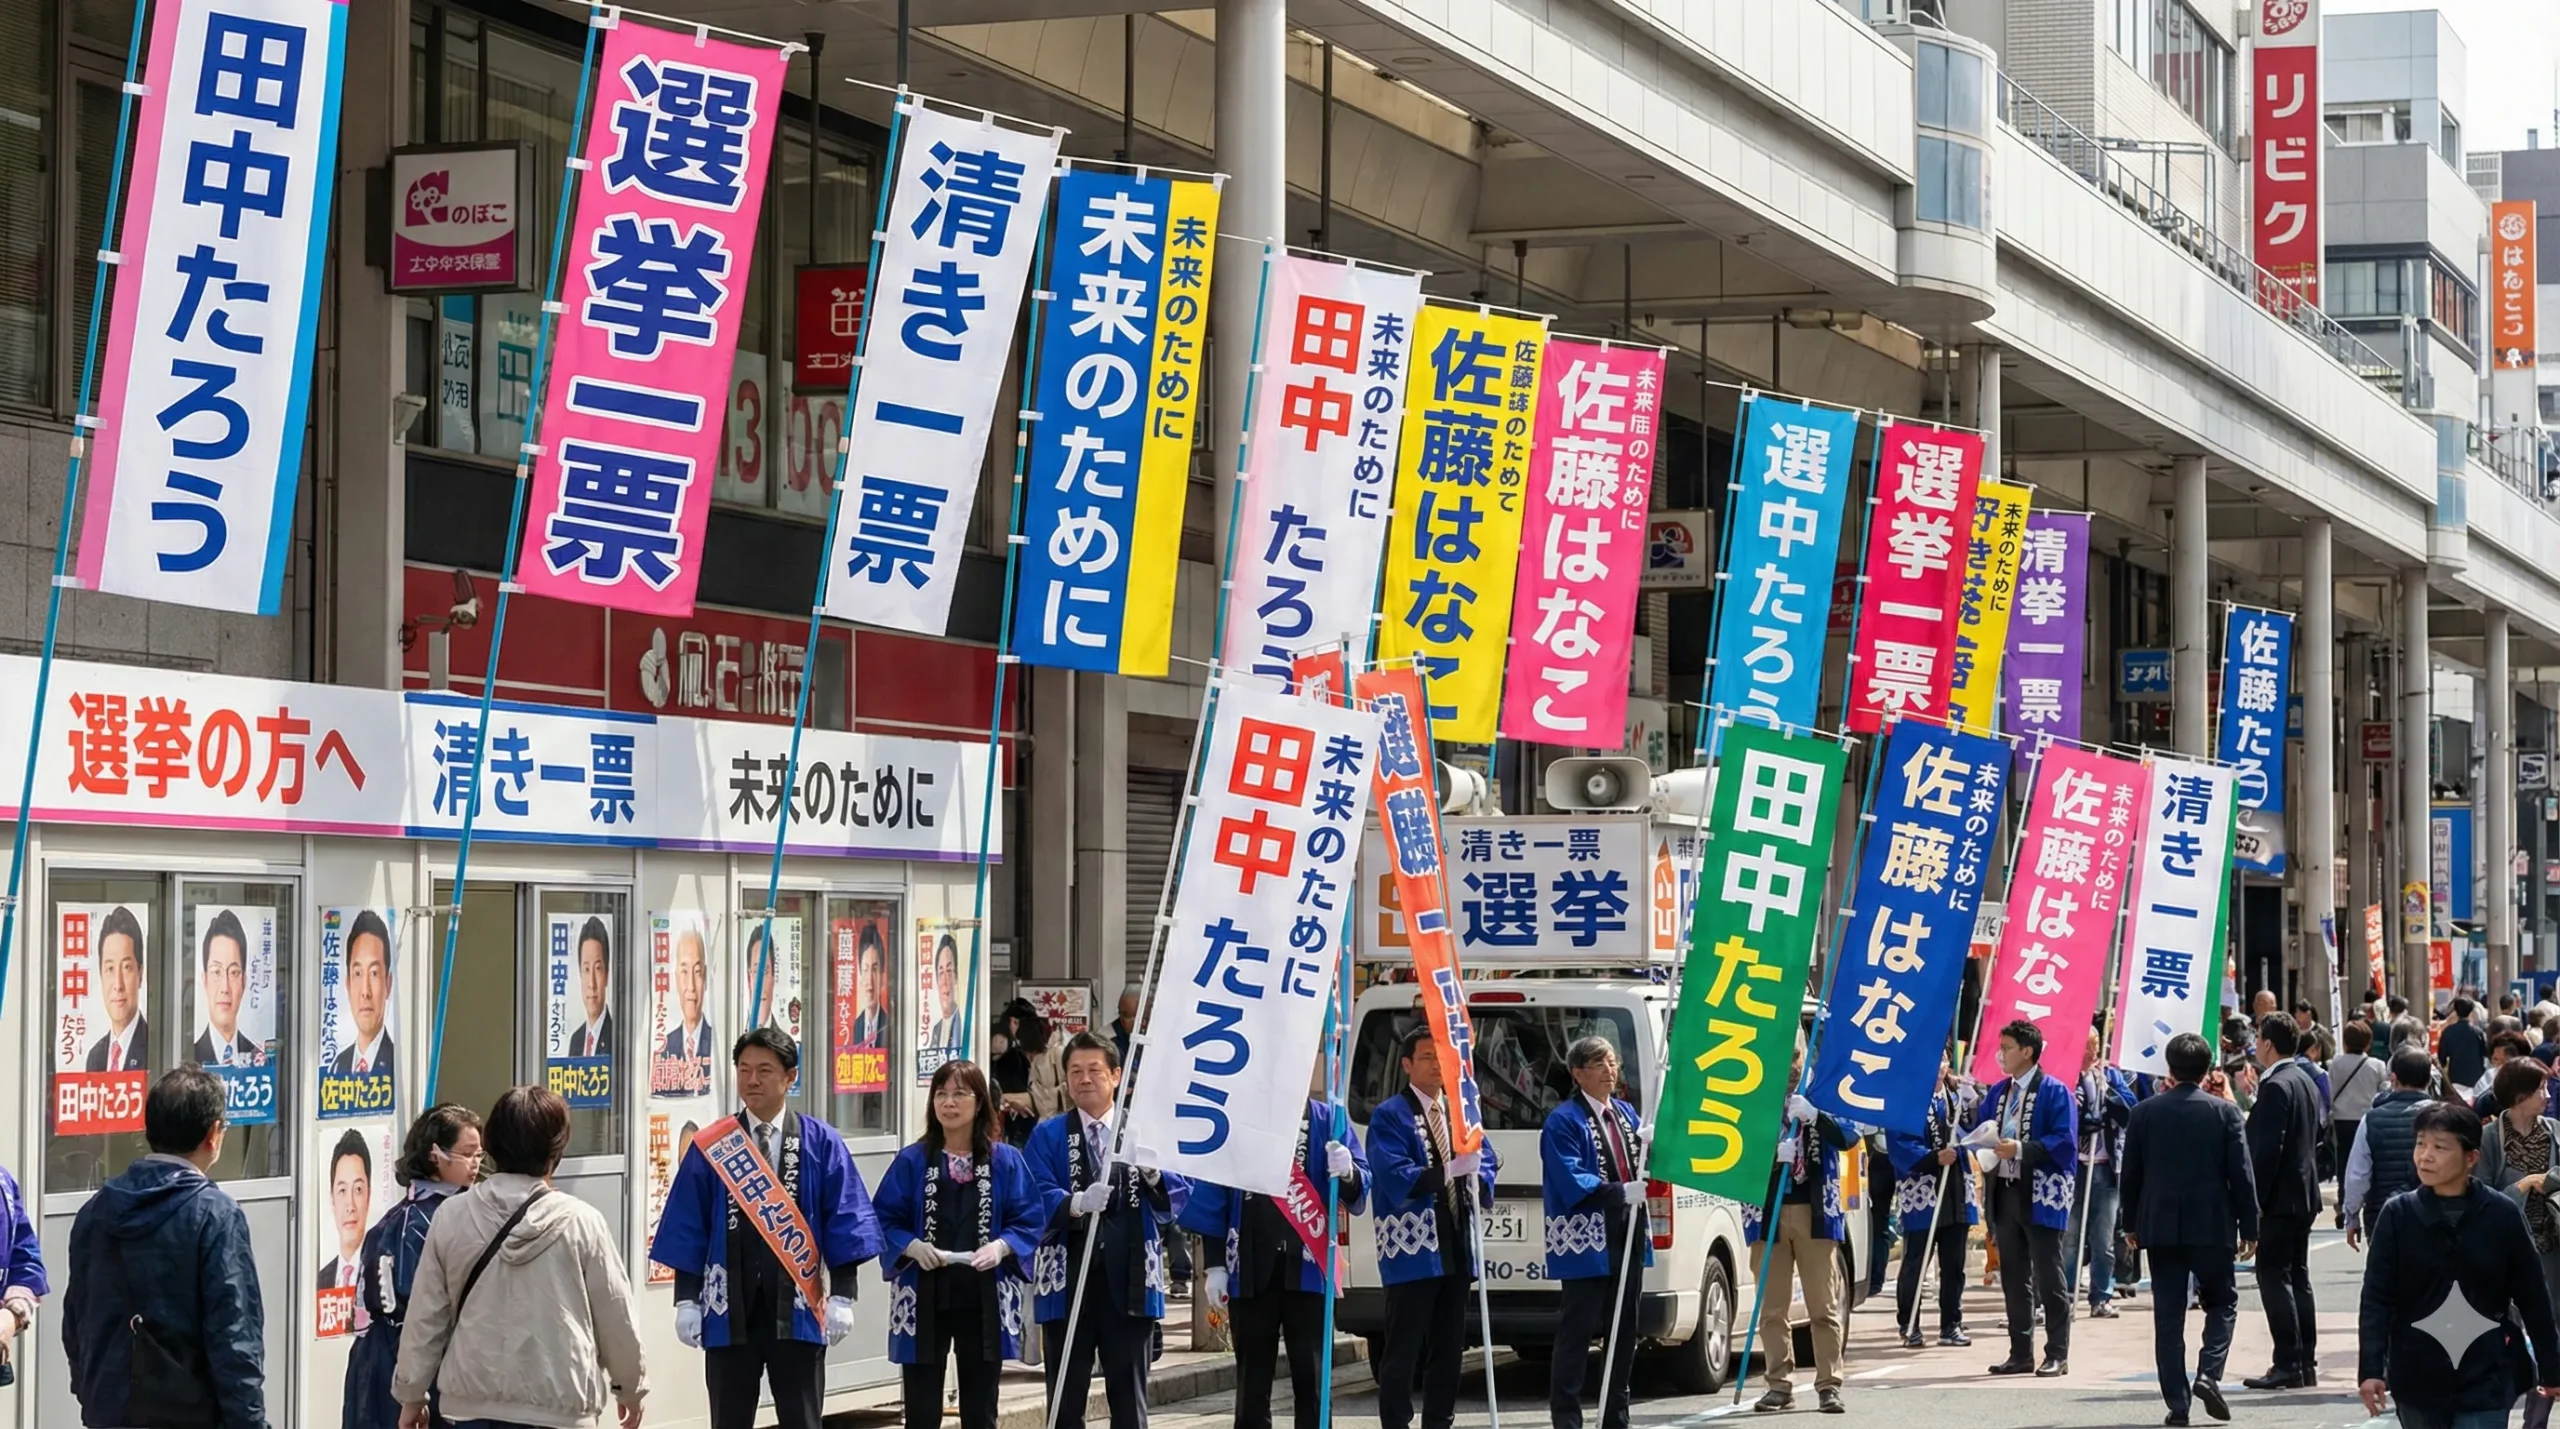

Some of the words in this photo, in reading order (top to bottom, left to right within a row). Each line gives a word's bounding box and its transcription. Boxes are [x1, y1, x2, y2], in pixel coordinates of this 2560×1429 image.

[2265, 73, 2306, 245] リビク
[151, 11, 307, 573] 田中たろう
[546, 57, 755, 588] 選挙一票
[847, 140, 1025, 590] 清き一票
[1153, 216, 1207, 440] 未来のために
[1280, 295, 1365, 452] 田中
[1042, 191, 1156, 648] 未来のために
[1349, 313, 1405, 521] 未来のために
[1404, 328, 1506, 720] 佐藤はなこ
[1532, 359, 1630, 732] 佐藤はなこ
[1867, 440, 1964, 710] 選挙一票
[1990, 502, 2022, 611] 未来のために
[68, 691, 366, 806] 選挙の方へ
[432, 718, 635, 825] 清き一票
[730, 750, 935, 830] 未来のために
[1214, 717, 1316, 896] 田中
[1948, 763, 2001, 912] 未来のために
[1280, 734, 1364, 999] 未来のために
[1460, 828, 1601, 862] 清き一票
[1462, 869, 1629, 947] 選挙
[1837, 742, 1971, 1111] 佐藤はなこ
[2091, 784, 2134, 911] 未来のために
[1174, 916, 1270, 1156] たろう
[1687, 748, 1826, 1174] 田中たろう
[58, 1080, 143, 1123] 田中たろう
[226, 1074, 273, 1108] たろう
[548, 1065, 610, 1099] 田中たろう
